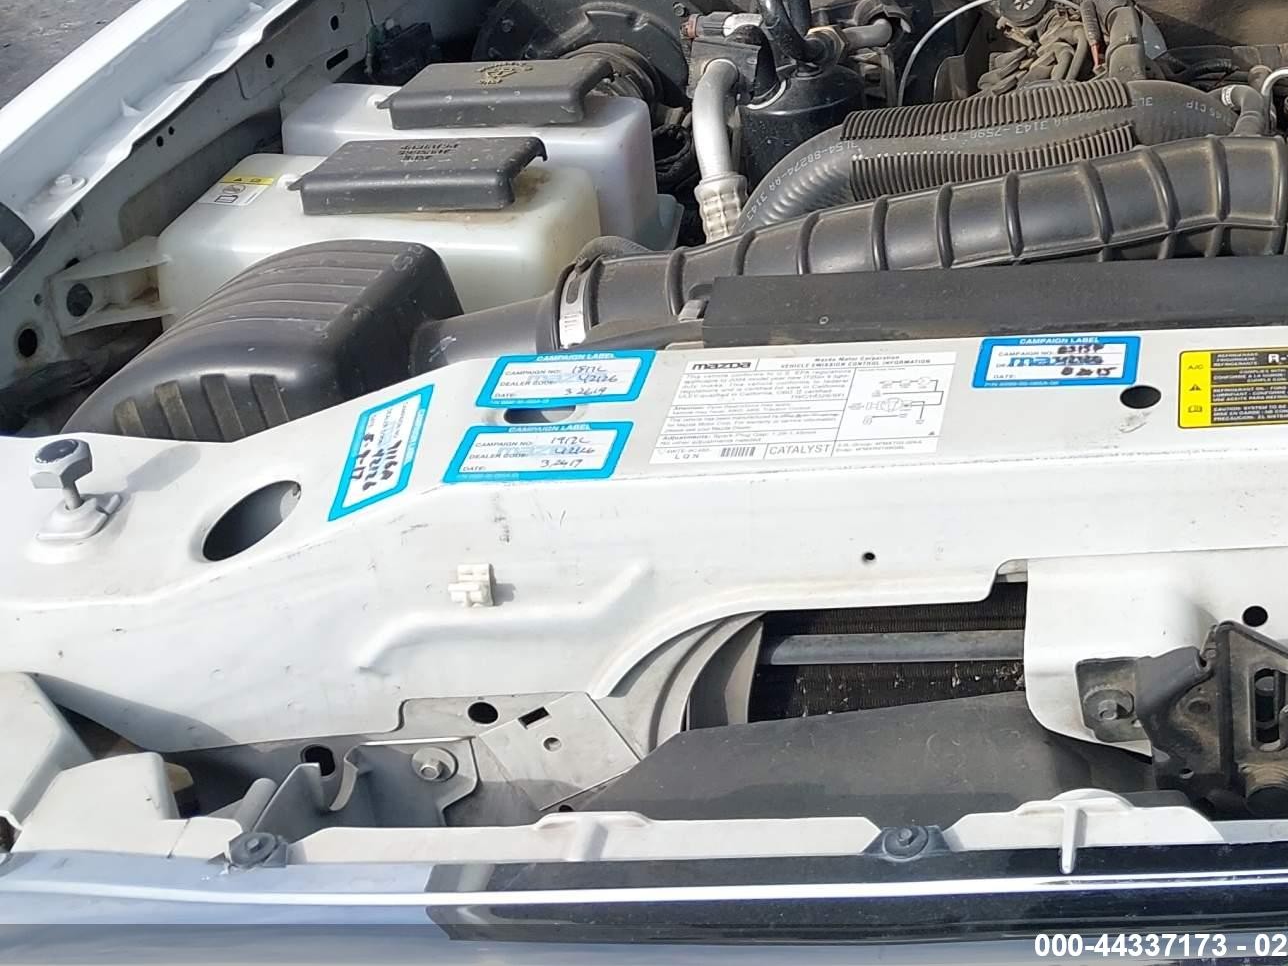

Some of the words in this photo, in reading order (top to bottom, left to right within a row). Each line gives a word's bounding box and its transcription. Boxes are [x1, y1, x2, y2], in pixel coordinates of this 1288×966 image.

[1019, 337, 1069, 345] CAMPAIGN
[1070, 336, 1101, 344] LABEL
[536, 354, 587, 362] CAMPAIGN
[691, 361, 752, 371] mazda
[509, 425, 560, 433] CAMPAIGN
[769, 444, 831, 455] CATALYST
